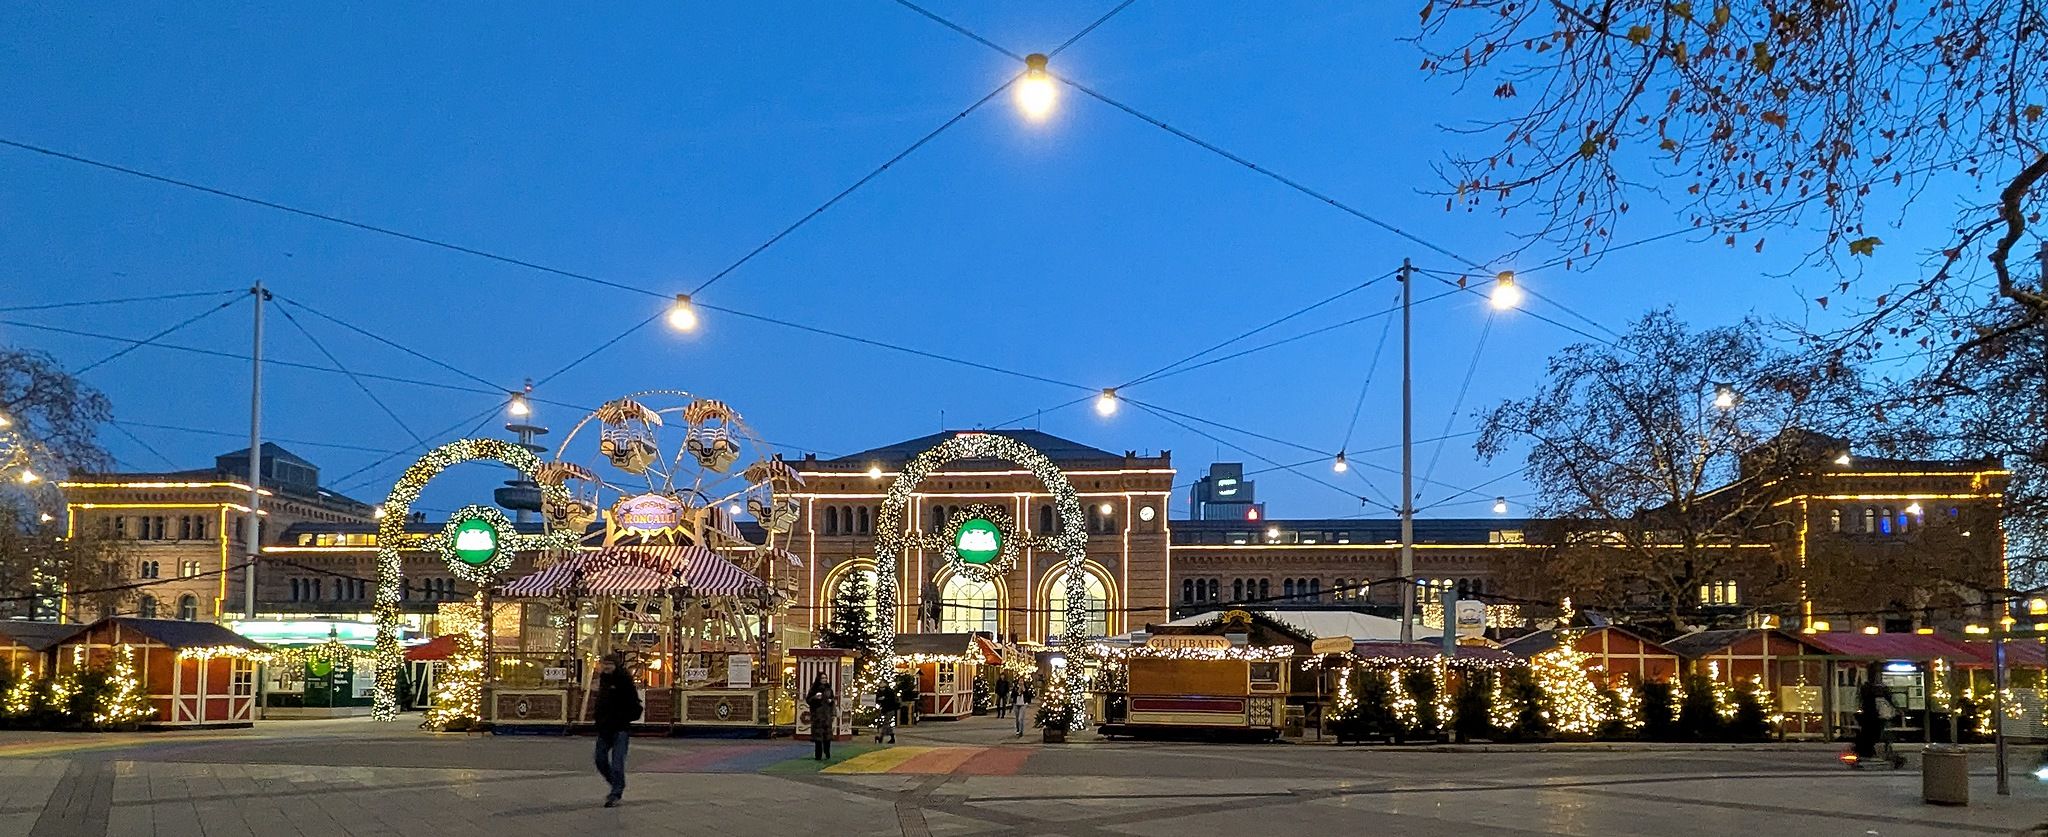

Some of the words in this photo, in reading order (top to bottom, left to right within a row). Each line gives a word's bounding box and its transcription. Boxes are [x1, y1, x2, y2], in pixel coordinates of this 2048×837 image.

[624, 513, 676, 524] RONCALLI
[583, 550, 672, 575] RIESENRAD
[1151, 636, 1224, 648] GLÜHBAHN
